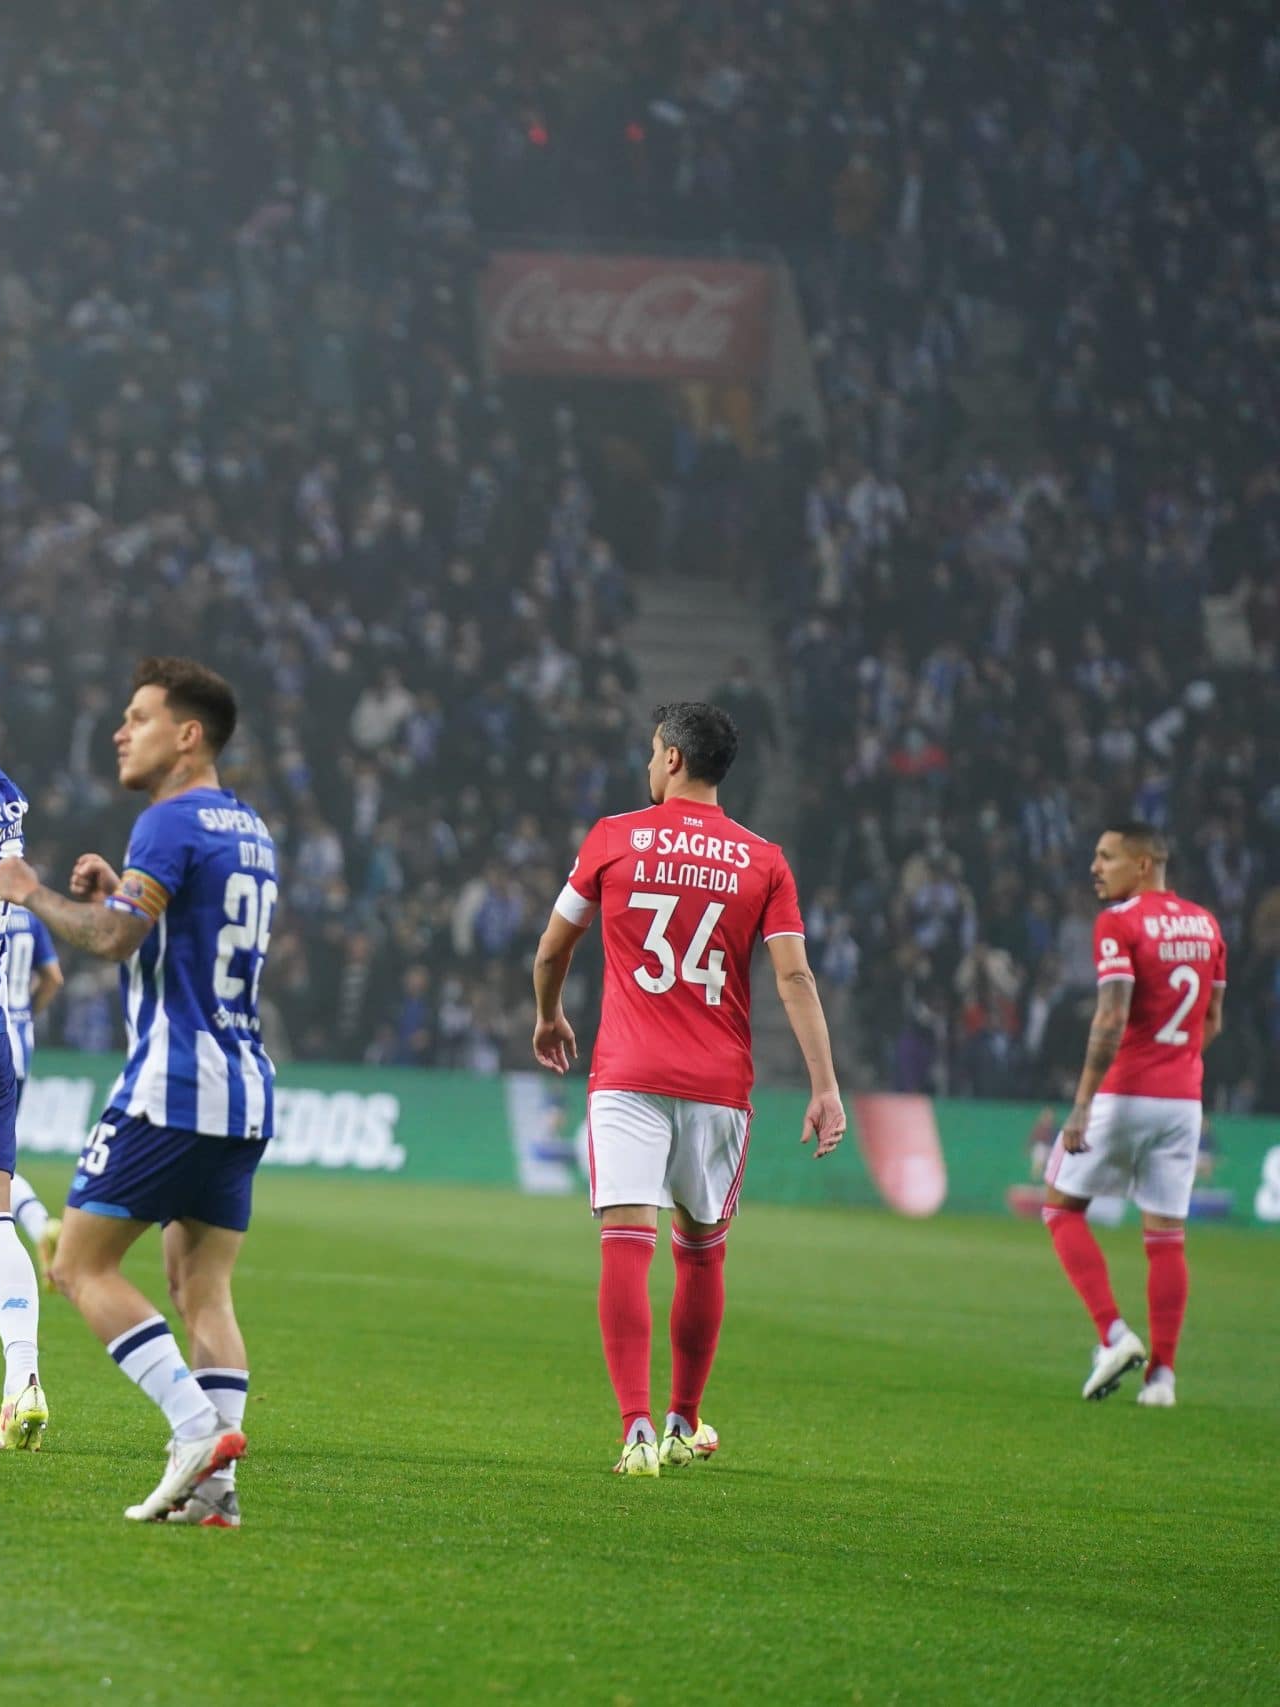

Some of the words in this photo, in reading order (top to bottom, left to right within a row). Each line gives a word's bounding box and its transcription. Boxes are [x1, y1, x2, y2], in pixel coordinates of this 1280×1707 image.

[657, 828, 751, 869] SAGRES
[628, 892, 729, 1006] 34
[1160, 914, 1214, 940] SAGRES
[1154, 965, 1200, 1045] 2
